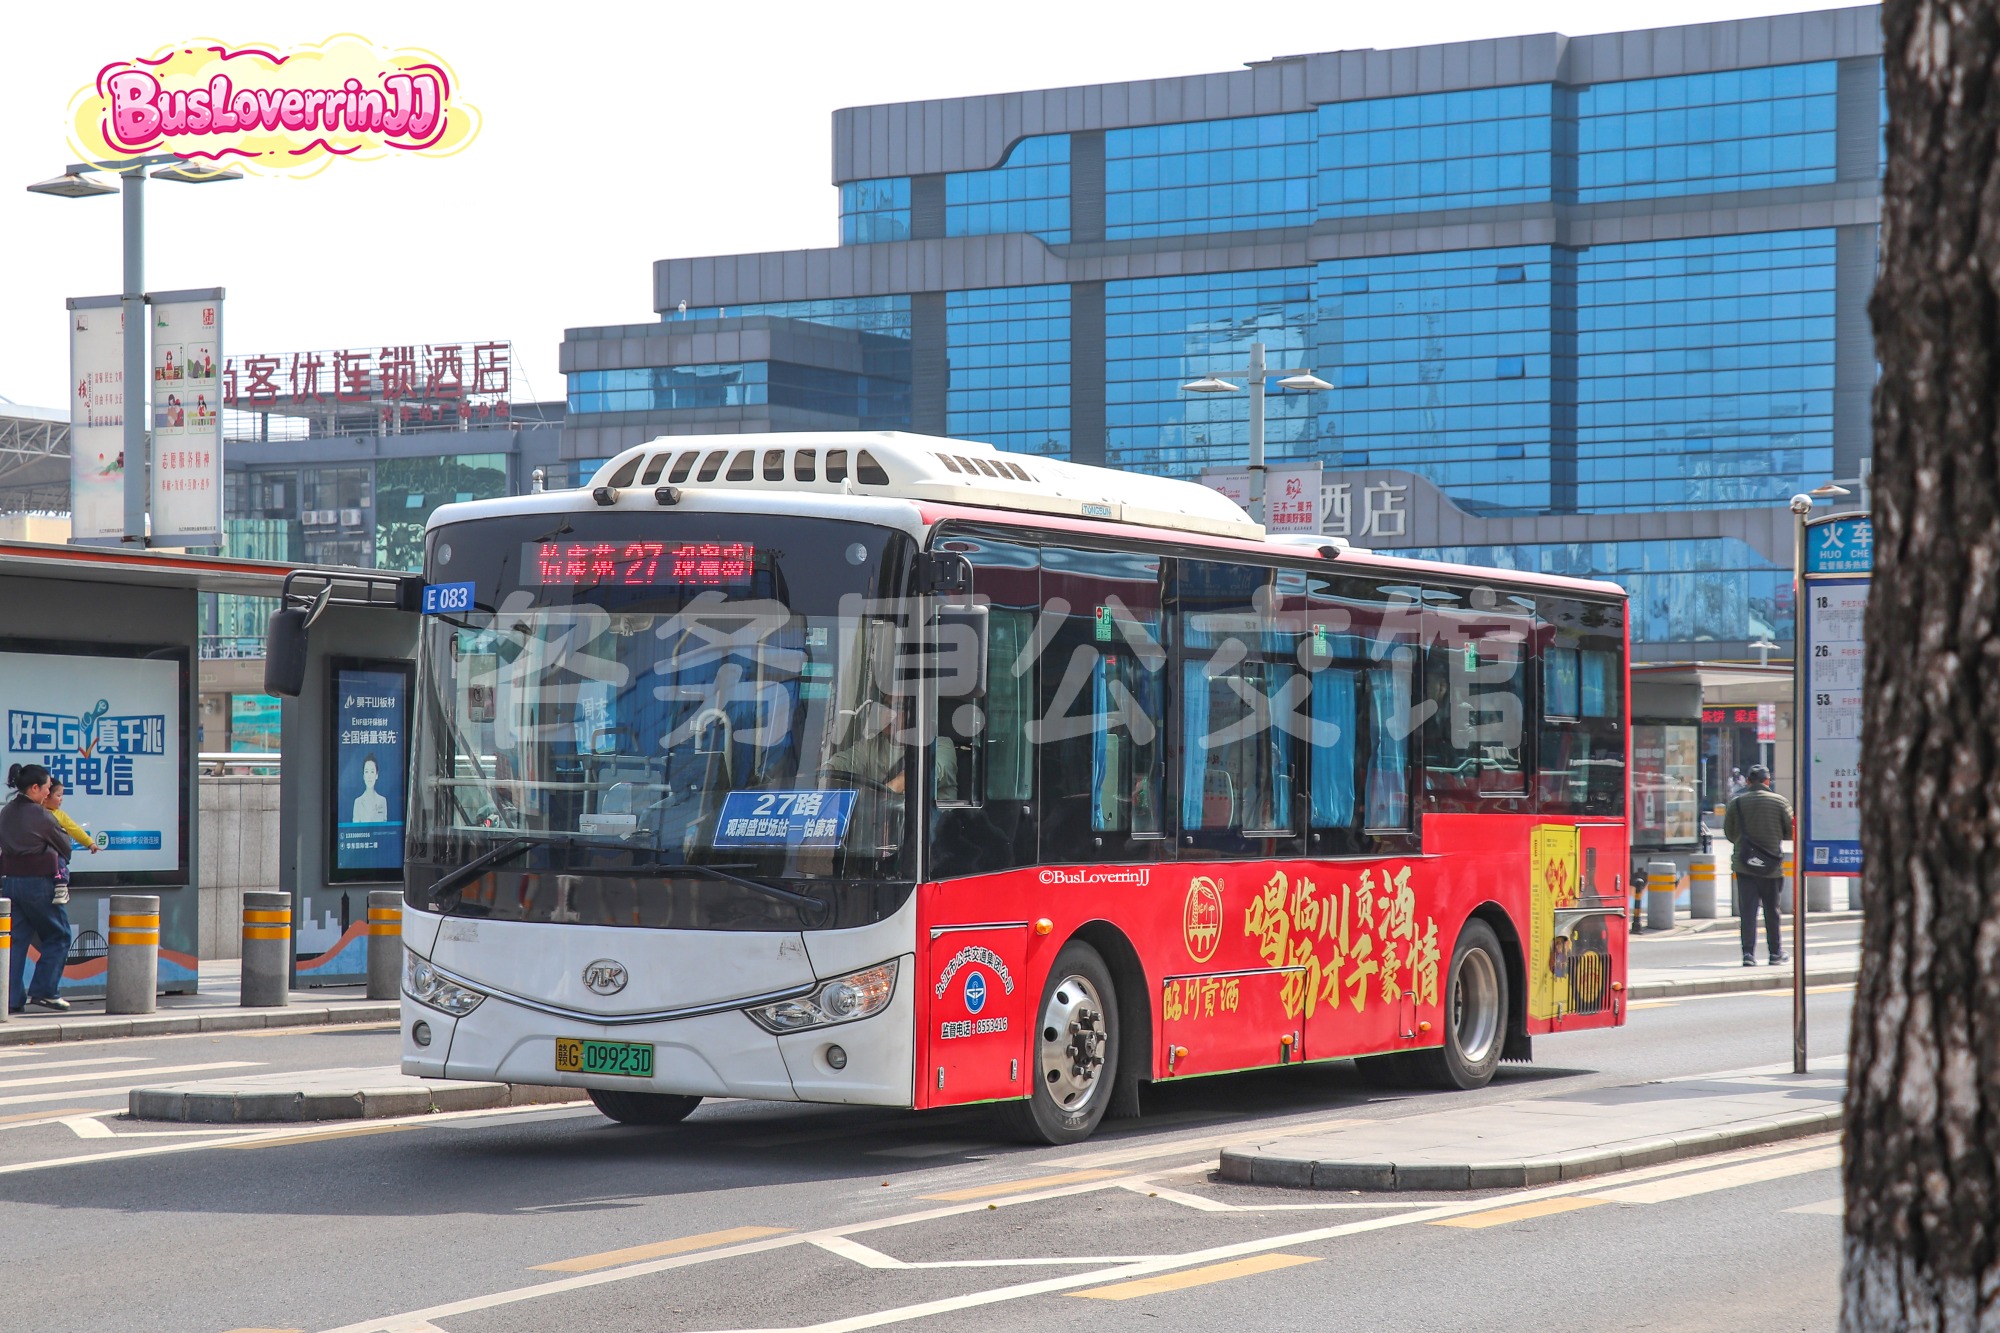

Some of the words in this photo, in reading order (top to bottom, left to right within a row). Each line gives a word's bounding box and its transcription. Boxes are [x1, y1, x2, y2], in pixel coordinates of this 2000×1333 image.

[624, 544, 663, 583] 27
[1819, 550, 1842, 559] HUO
[1850, 550, 1869, 558] CHE
[427, 590, 436, 610] E
[440, 588, 468, 608] 083
[1816, 597, 1828, 608] 18
[1815, 645, 1829, 657] 26
[1817, 694, 1830, 706] 53
[11, 713, 80, 750] 好5G
[99, 718, 162, 753] 真千兆
[44, 754, 133, 795] 选电信
[753, 793, 823, 816] 27路
[1244, 865, 1416, 969] 喝临川贡酒
[936, 946, 1014, 1000] 九江市公共交通集团公司
[1280, 916, 1441, 1020] 扬才子豪情
[558, 1043, 579, 1066] 赣G
[587, 1046, 651, 1072] 09923D
